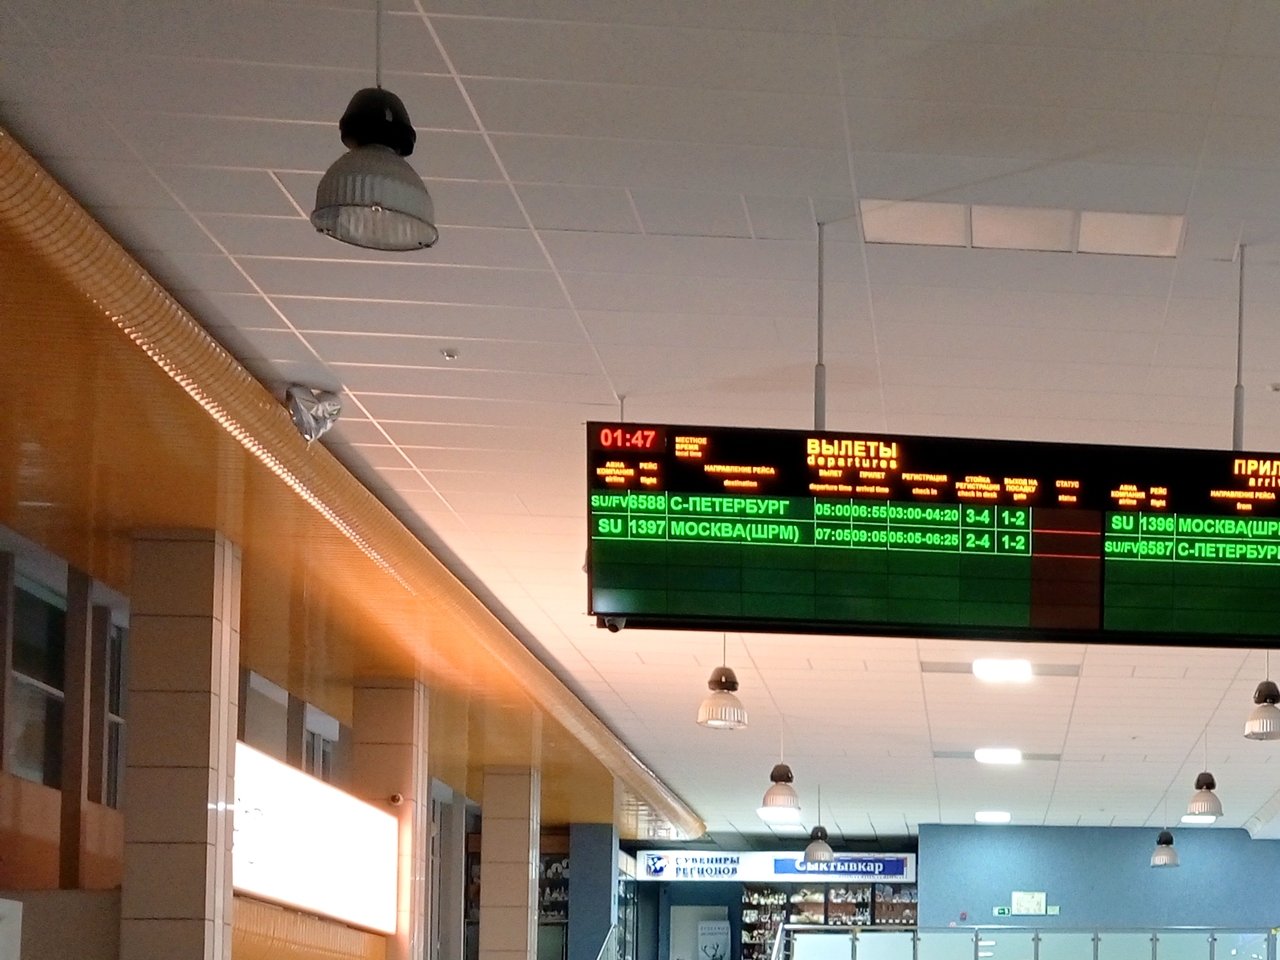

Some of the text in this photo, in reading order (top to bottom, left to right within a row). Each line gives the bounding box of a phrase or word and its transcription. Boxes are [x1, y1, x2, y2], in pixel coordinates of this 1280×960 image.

[600, 428, 656, 448] 01:47
[675, 436, 707, 445] МЕСТНОЕ
[675, 443, 699, 451] ВРЕМЯ
[807, 438, 897, 458] ВЫЛЕТЫ
[807, 454, 897, 469] departures
[596, 468, 634, 476] КОМПАНИЯ
[704, 464, 775, 475] НАПРАВЛЕНИЕ РЕЙСА
[819, 469, 842, 478] ВЫЛЕТ
[860, 470, 886, 479] ПРИЛЕТ
[902, 473, 948, 482] РЕГИСТРАЦИЯ
[1004, 478, 1028, 486] ВЫХОД
[1056, 480, 1080, 488] СТАТУС
[1006, 484, 1036, 493] ПОСАДКУ
[1150, 487, 1168, 496] РЕЙС
[1254, 492, 1276, 500] РЕЙСА
[591, 494, 1025, 526] SU/FV 6588 С-ПЕТЕРБУРГ 05:00 06:55 03:00-04:20 3-4 1-2
[1112, 516, 1134, 530] SU
[1140, 516, 1174, 532] 1396
[598, 518, 1025, 550] SU 1397 МОСКВА(ШРМ) 07:05 09:05 05:05-06:25 2-4 1-2
[1105, 541, 1140, 554] SU/FV
[1140, 541, 1174, 556] 6587
[675, 856, 740, 866] СУВЕНИРЫ
[675, 866, 738, 876] РЕГИОНОВ
[795, 857, 884, 876] Сыктывкар
